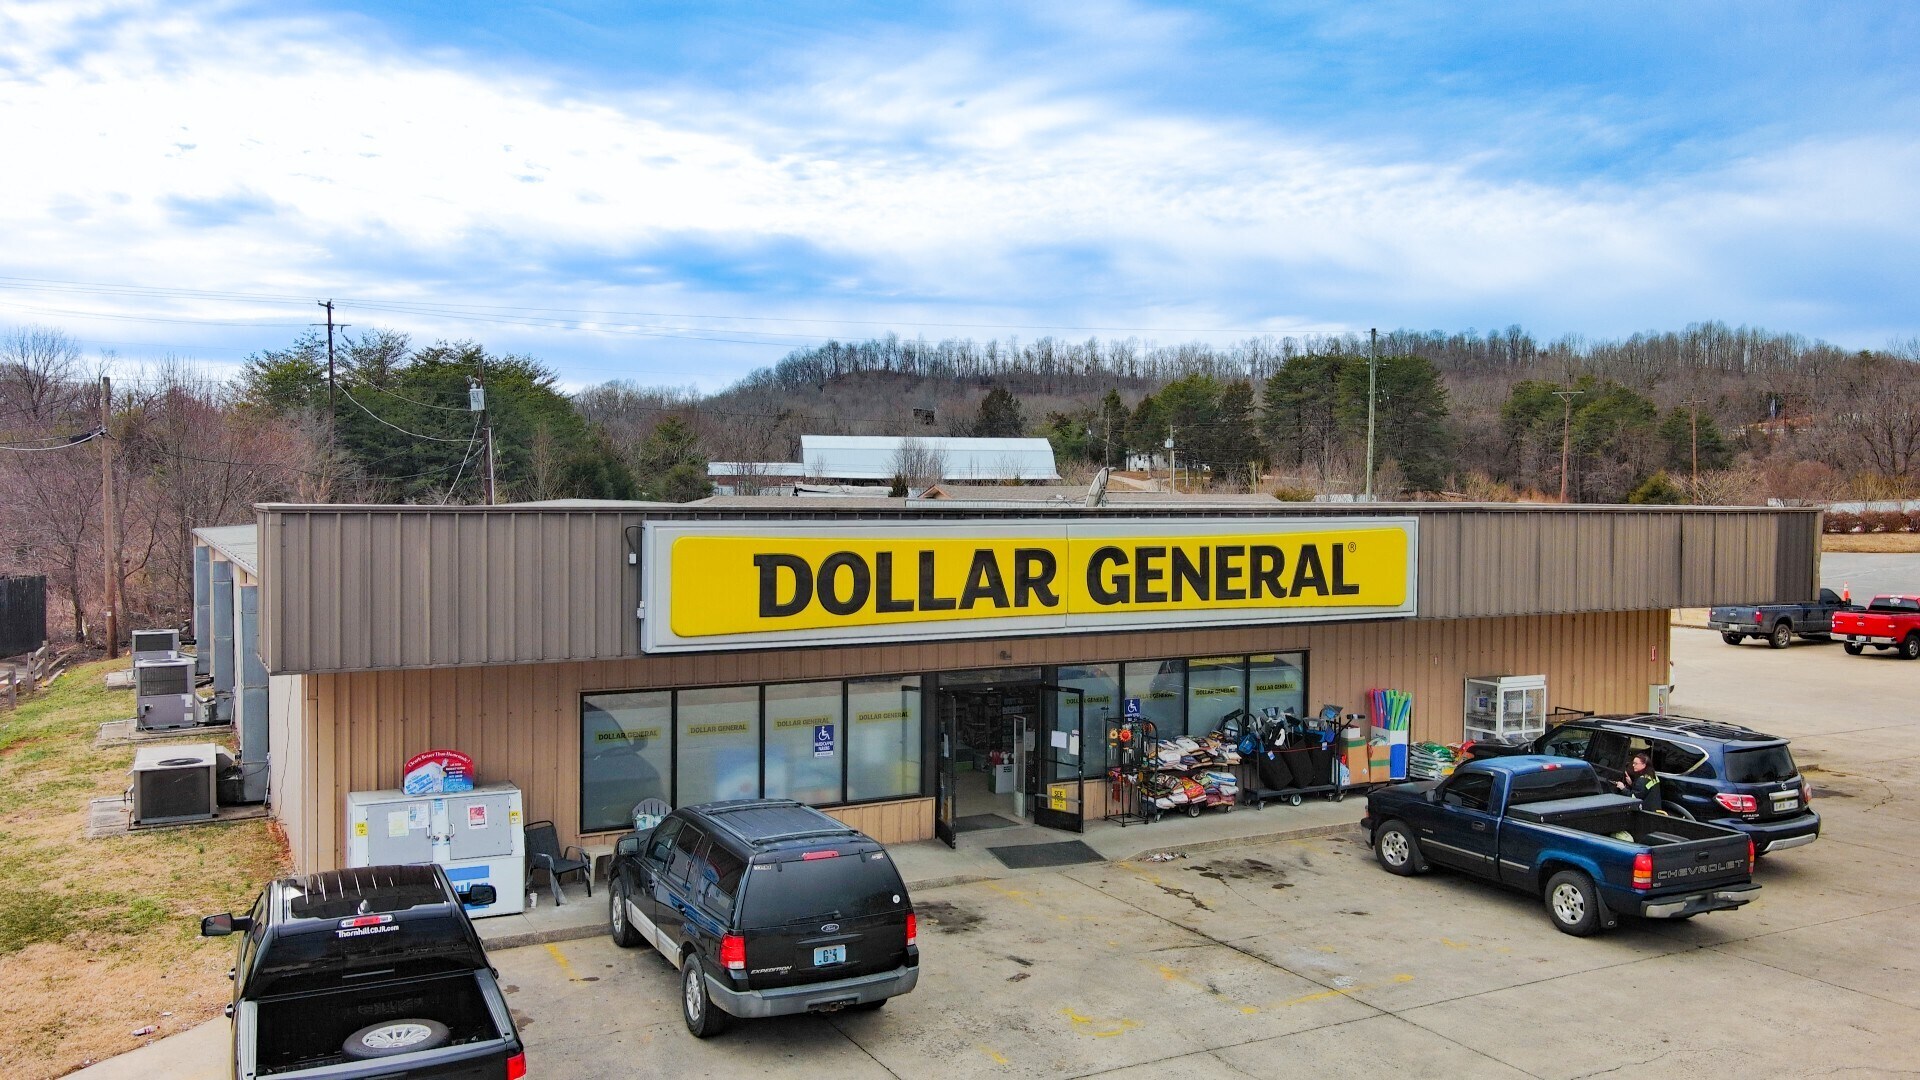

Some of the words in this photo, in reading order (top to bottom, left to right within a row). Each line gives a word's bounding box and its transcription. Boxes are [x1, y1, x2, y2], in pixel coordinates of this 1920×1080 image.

[753, 547, 1060, 618] DOLLAR
[1086, 542, 1360, 606] GENERAL
[882, 711, 909, 719] GENERAL
[717, 723, 747, 732] GENERAL
[776, 720, 802, 728] DOLLAR
[598, 732, 626, 741] DOLLAR
[627, 729, 659, 738] GENERAL
[1657, 860, 1744, 879] CHEVROLET
